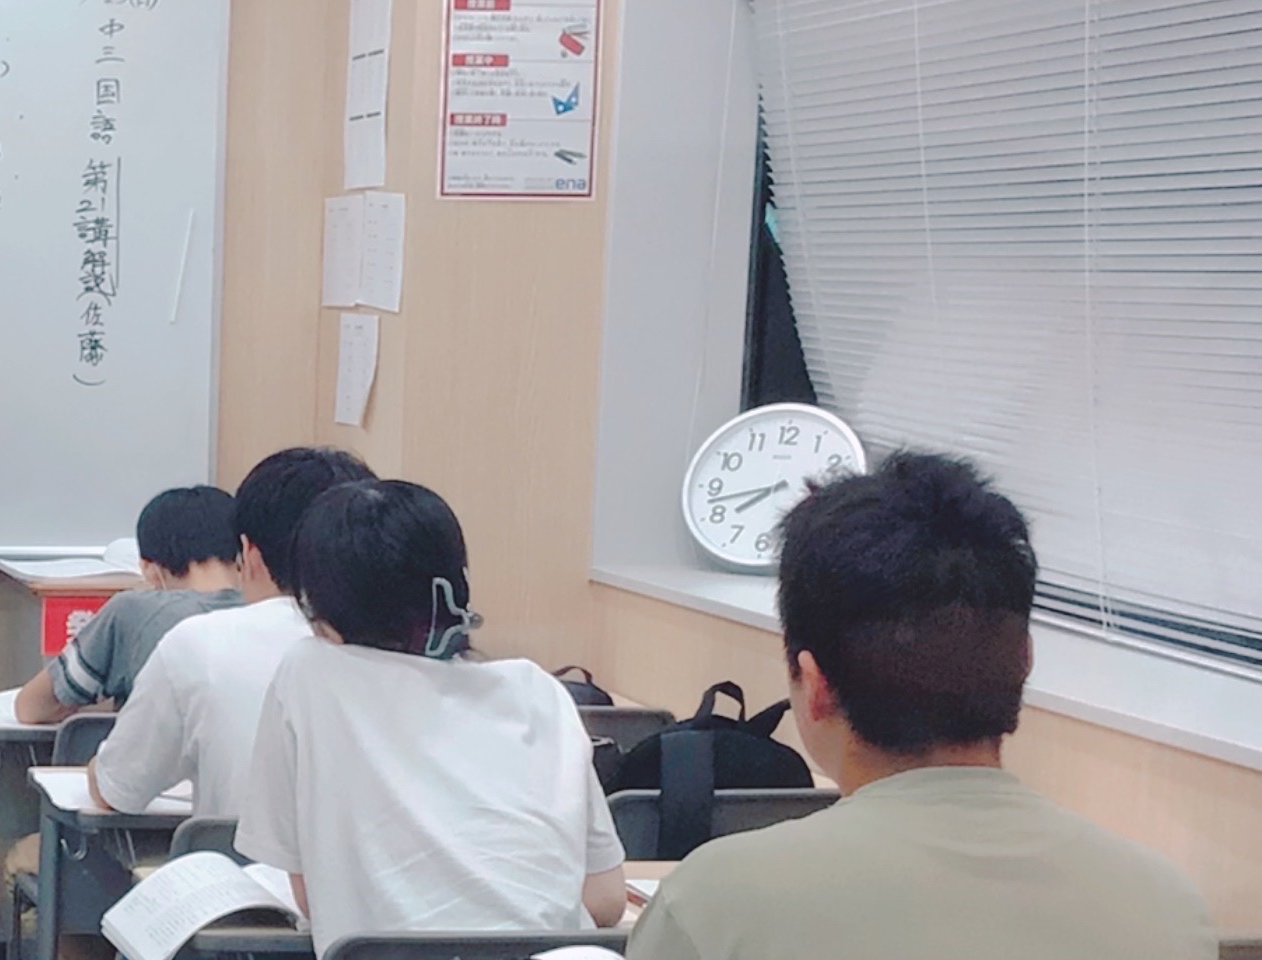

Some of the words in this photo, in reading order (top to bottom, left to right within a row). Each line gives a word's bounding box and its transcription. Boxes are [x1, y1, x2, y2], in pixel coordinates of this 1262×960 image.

[555, 178, 586, 190] ena
[748, 433, 766, 451] 11
[778, 426, 800, 446] 12
[813, 435, 823, 453] 1
[721, 452, 743, 472] 10
[826, 454, 842, 473] 2
[707, 478, 724, 497] 9
[709, 505, 726, 524] 8
[730, 525, 745, 544] 7
[754, 533, 769, 552] 6
